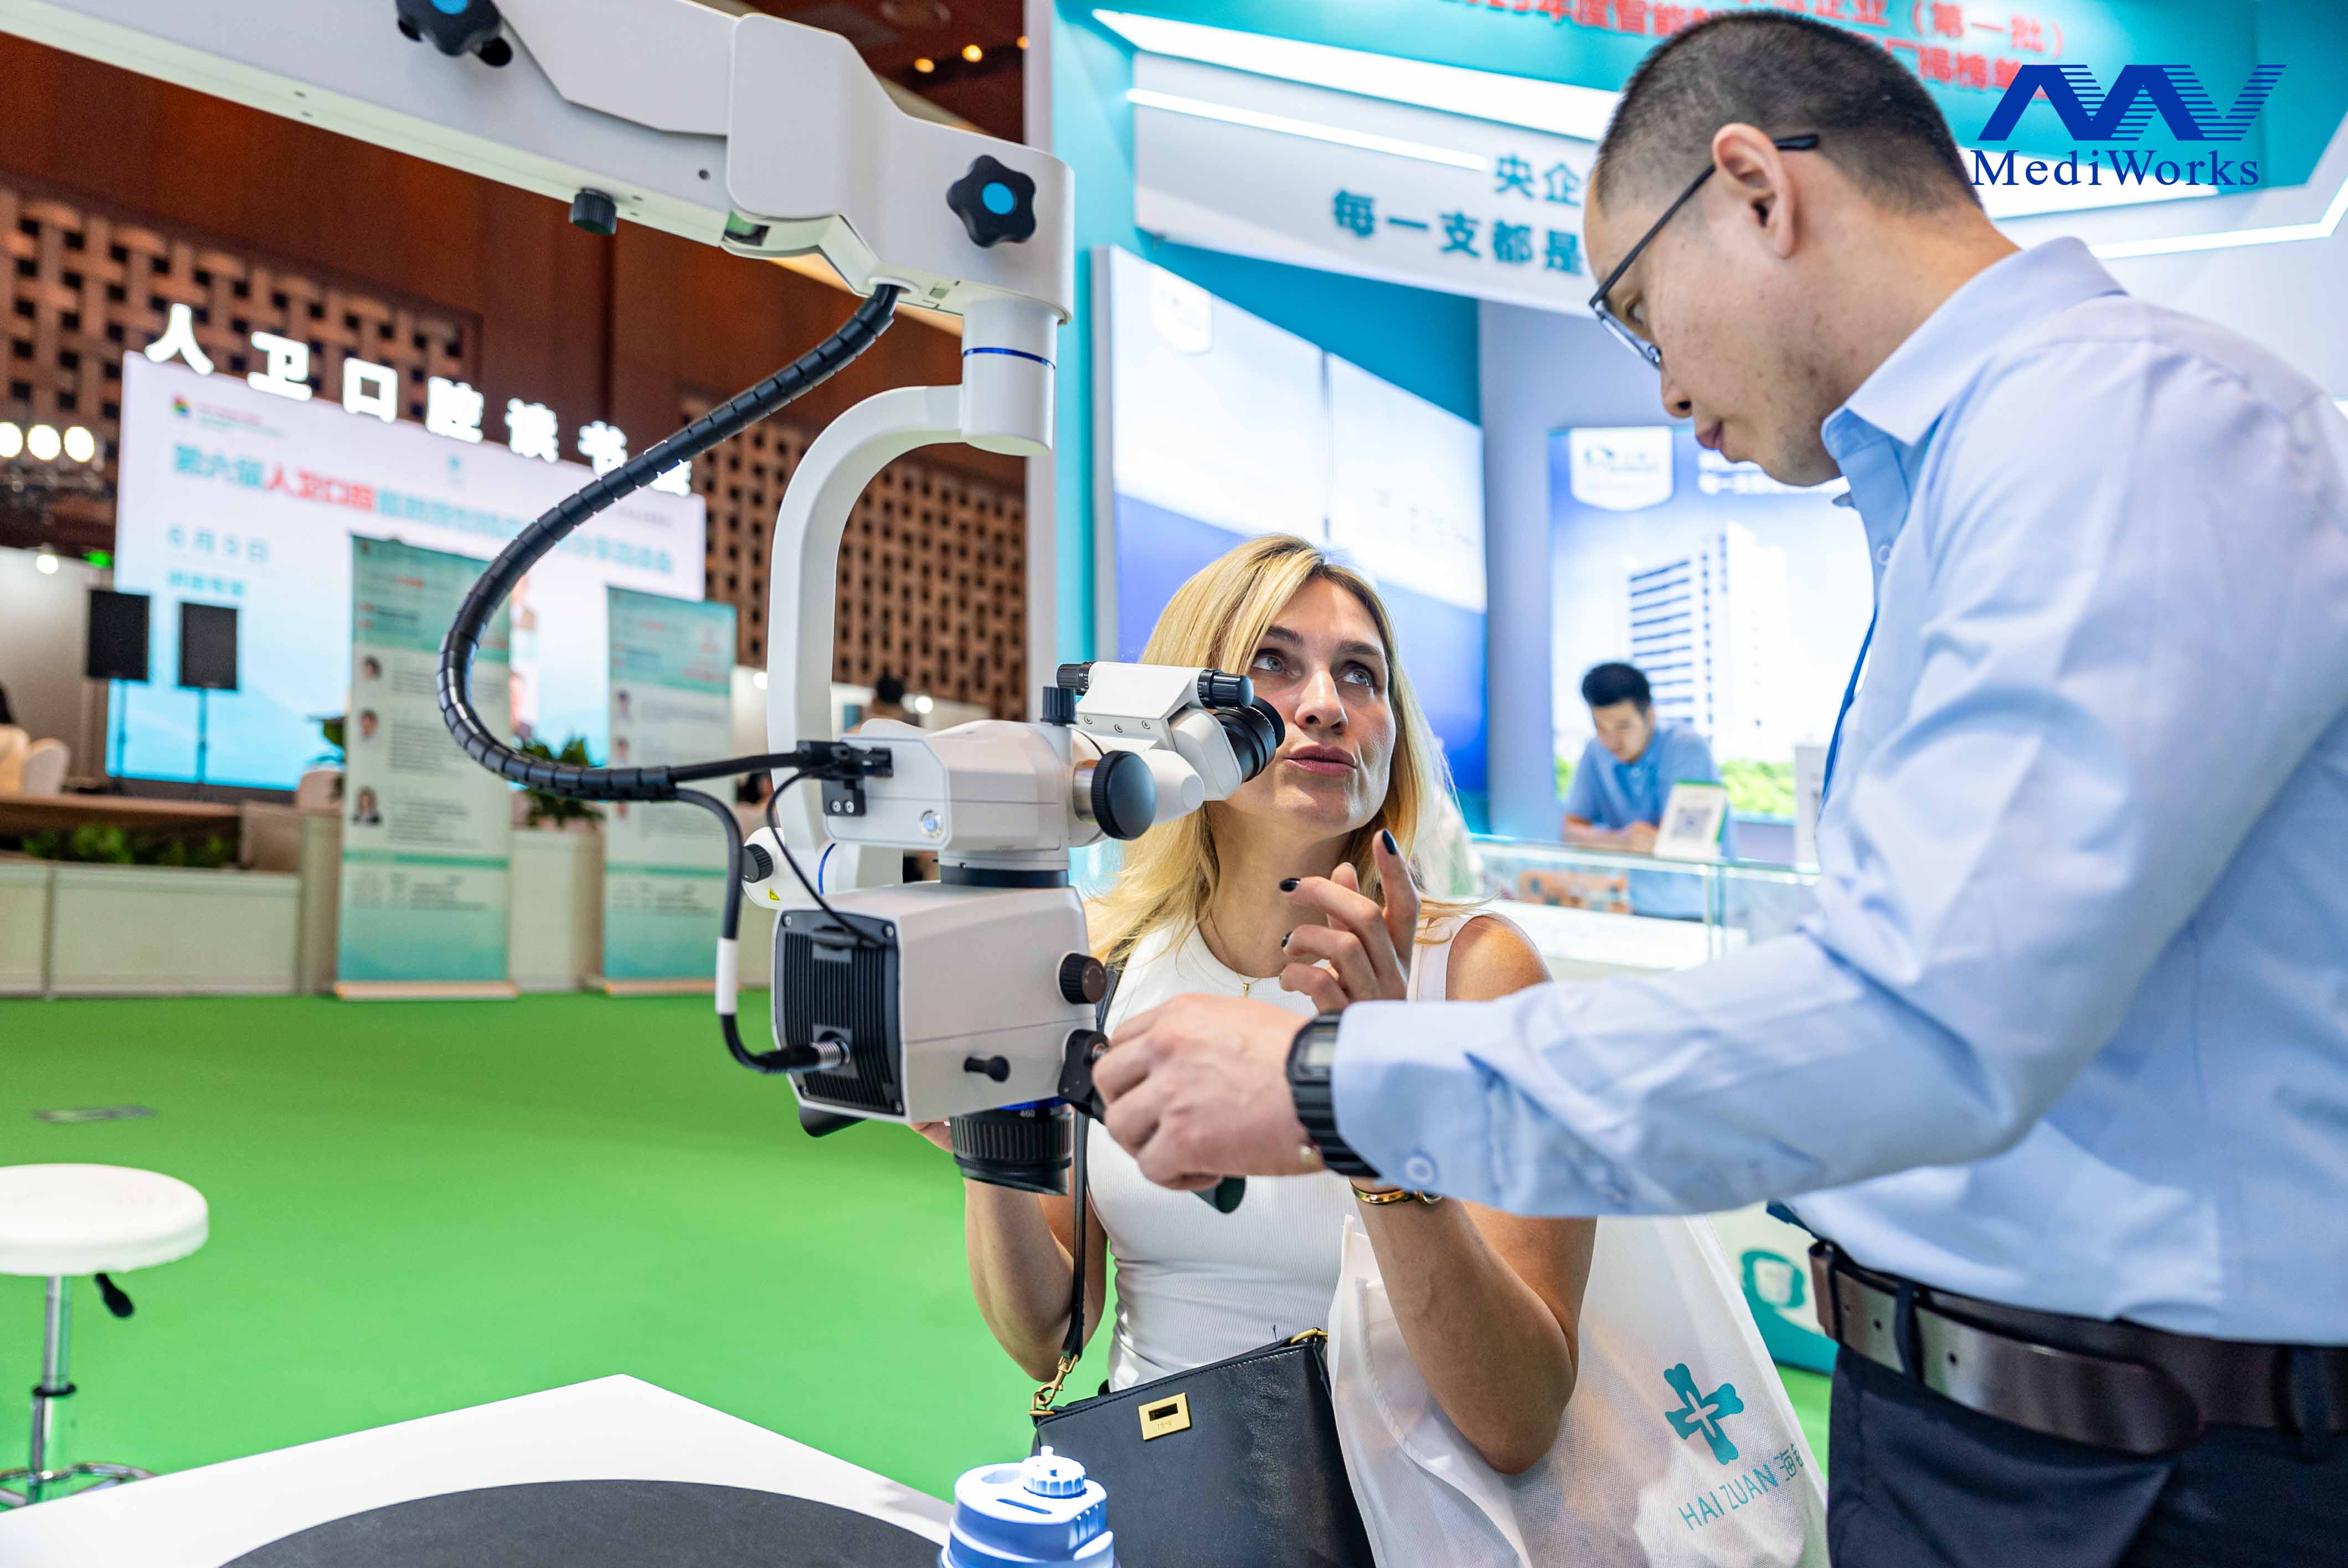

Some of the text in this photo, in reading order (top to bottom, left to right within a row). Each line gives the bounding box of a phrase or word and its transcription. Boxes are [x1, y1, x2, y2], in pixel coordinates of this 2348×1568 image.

[1494, 153, 1583, 208] 央企
[1332, 188, 1583, 276] 每一支都是
[1678, 1491, 1724, 1530] HAI
[1719, 1463, 1779, 1509] ZUAN
